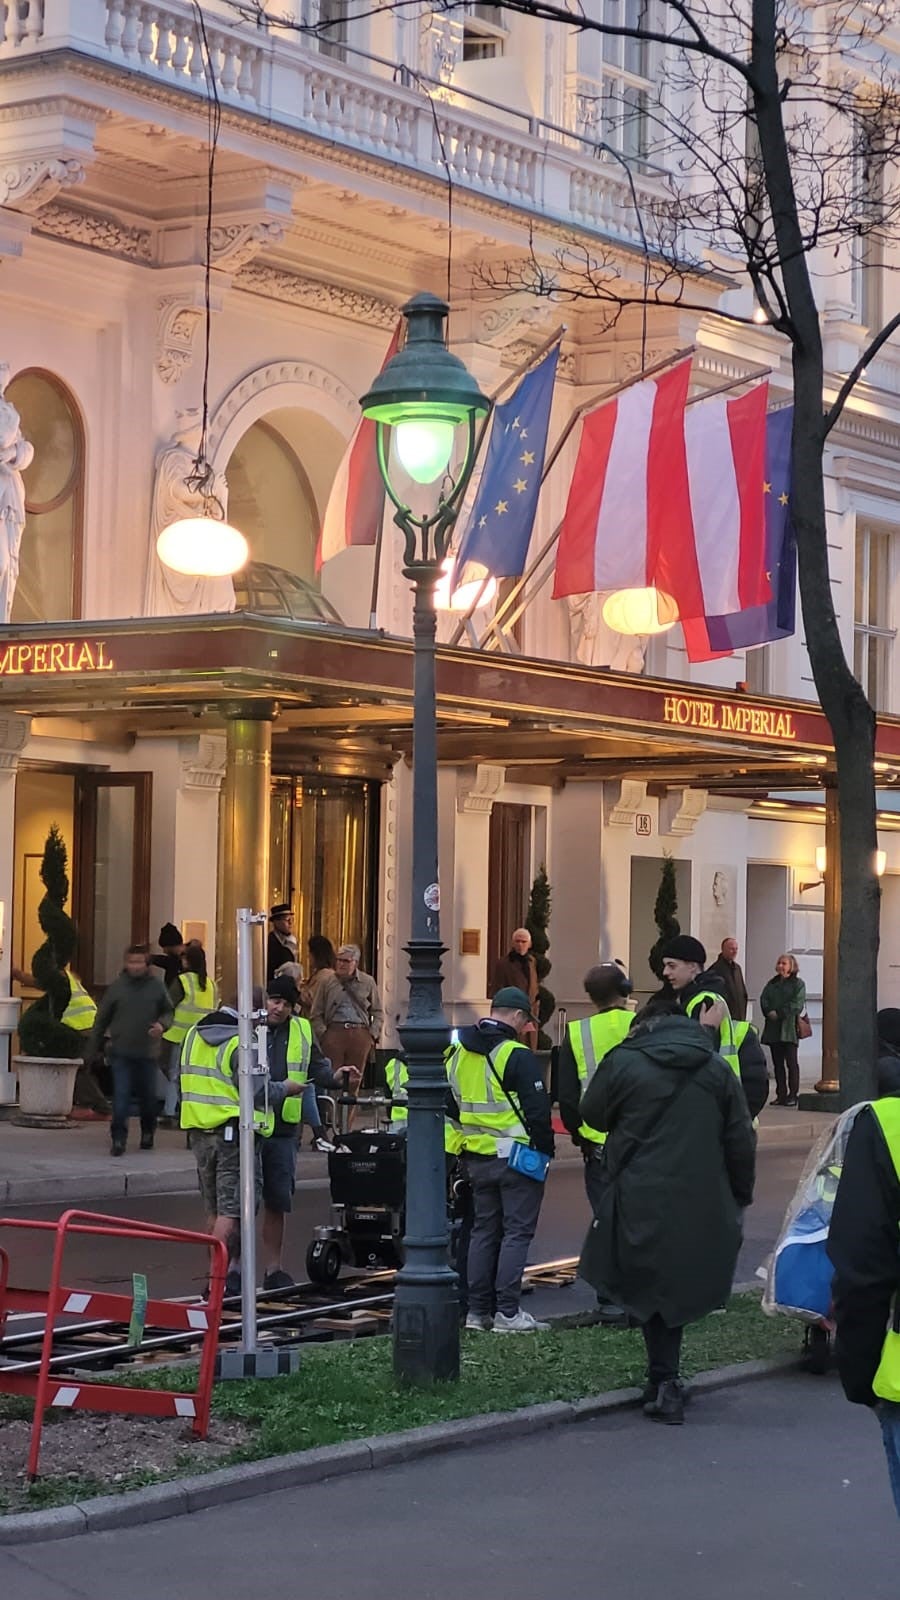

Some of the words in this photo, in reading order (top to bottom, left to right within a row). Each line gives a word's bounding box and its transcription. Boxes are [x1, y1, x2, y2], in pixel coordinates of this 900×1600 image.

[663, 697, 719, 728] HOTEL
[721, 704, 796, 738] IMPERIAL
[639, 816, 648, 829] 16
